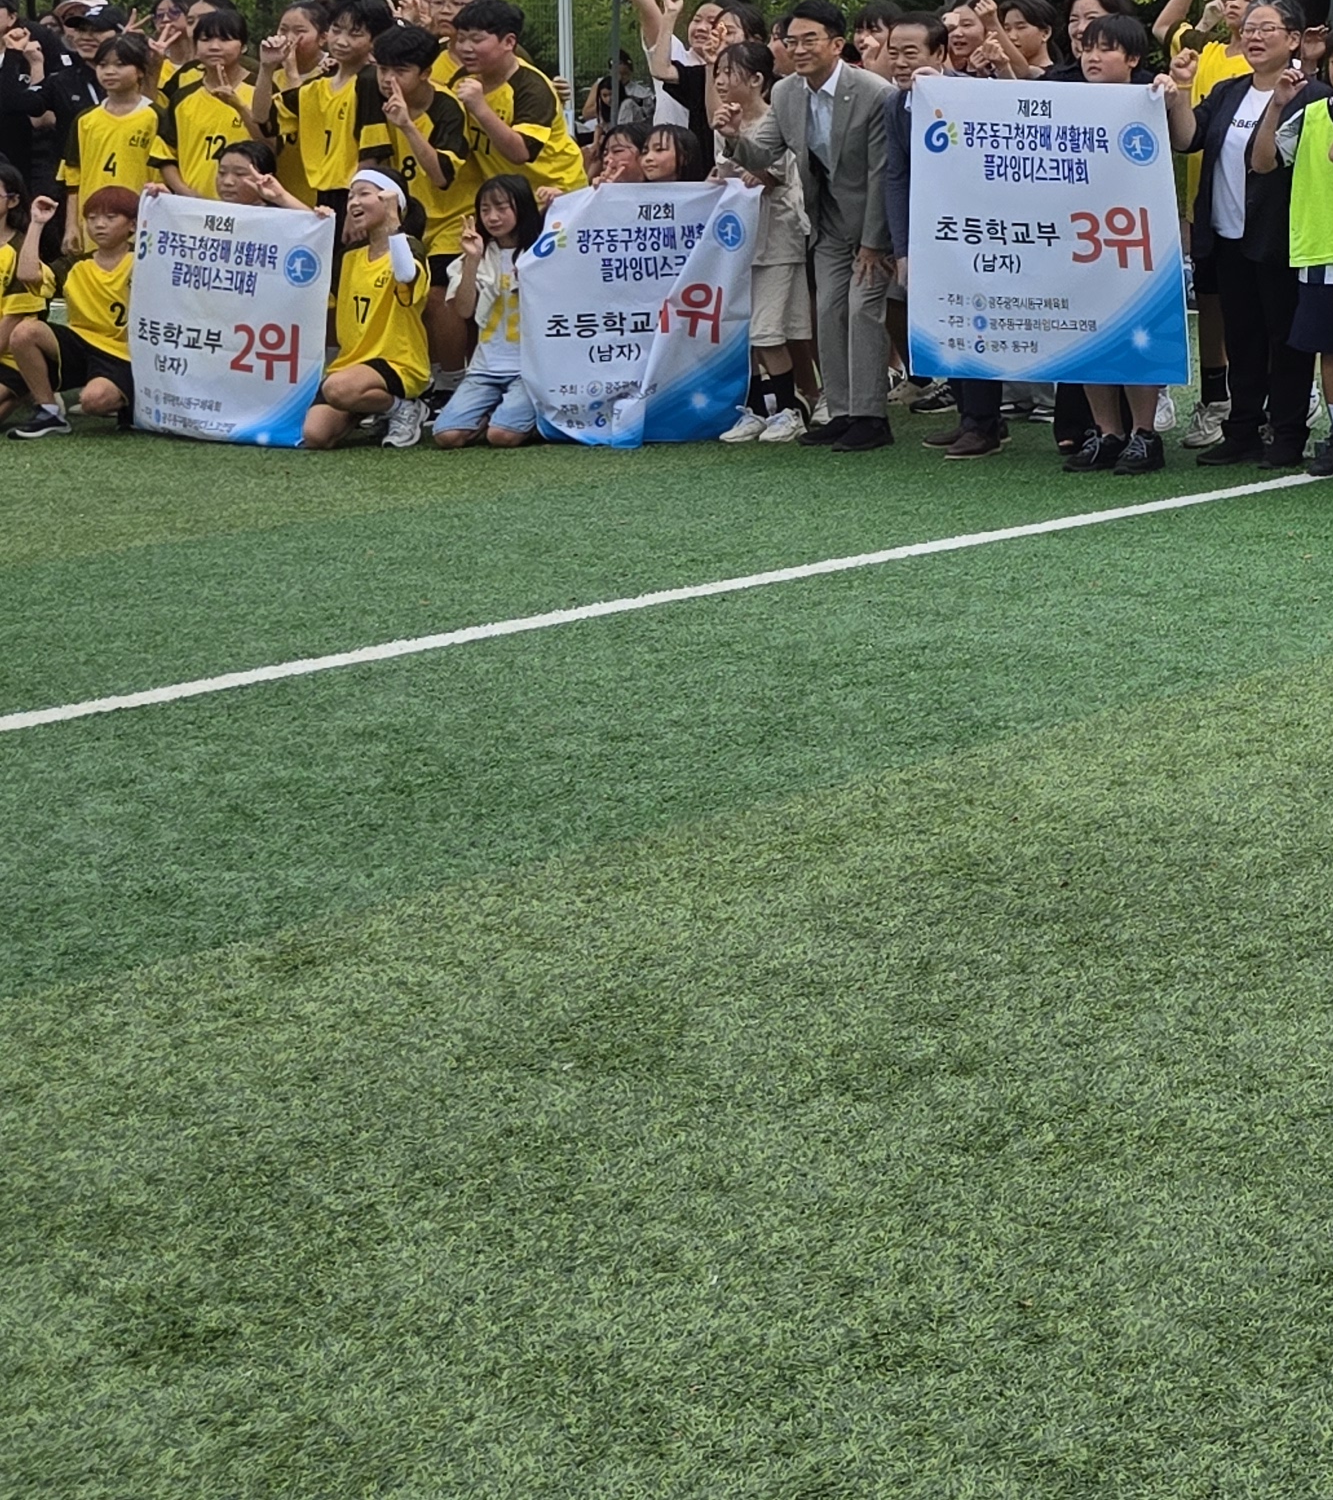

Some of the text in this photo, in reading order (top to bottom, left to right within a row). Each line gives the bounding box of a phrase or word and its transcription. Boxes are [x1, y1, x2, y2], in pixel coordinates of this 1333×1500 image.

[1017, 98, 1052, 118] 제2회
[205, 135, 227, 161] 12
[963, 121, 1110, 154] 광주동구청장배 생활체육
[103, 152, 117, 178] 4
[401, 155, 417, 182] 8
[983, 154, 1090, 185] 플라잉디스크대회
[203, 214, 236, 235] 제2회
[637, 202, 675, 221] 제2회
[157, 230, 279, 270] 광주동구청장배 생활체육
[576, 225, 677, 254] 광주동구청장배
[935, 206, 1154, 272] 초등학교부 3위
[973, 253, 1022, 274] (남자)
[171, 261, 258, 297] 플라잉디스크대회
[353, 295, 371, 324] 17
[544, 310, 663, 338] 초등학교
[138, 317, 300, 384] 초등학교부 2위
[588, 343, 642, 363] (남자)
[154, 353, 189, 376] (남자)
